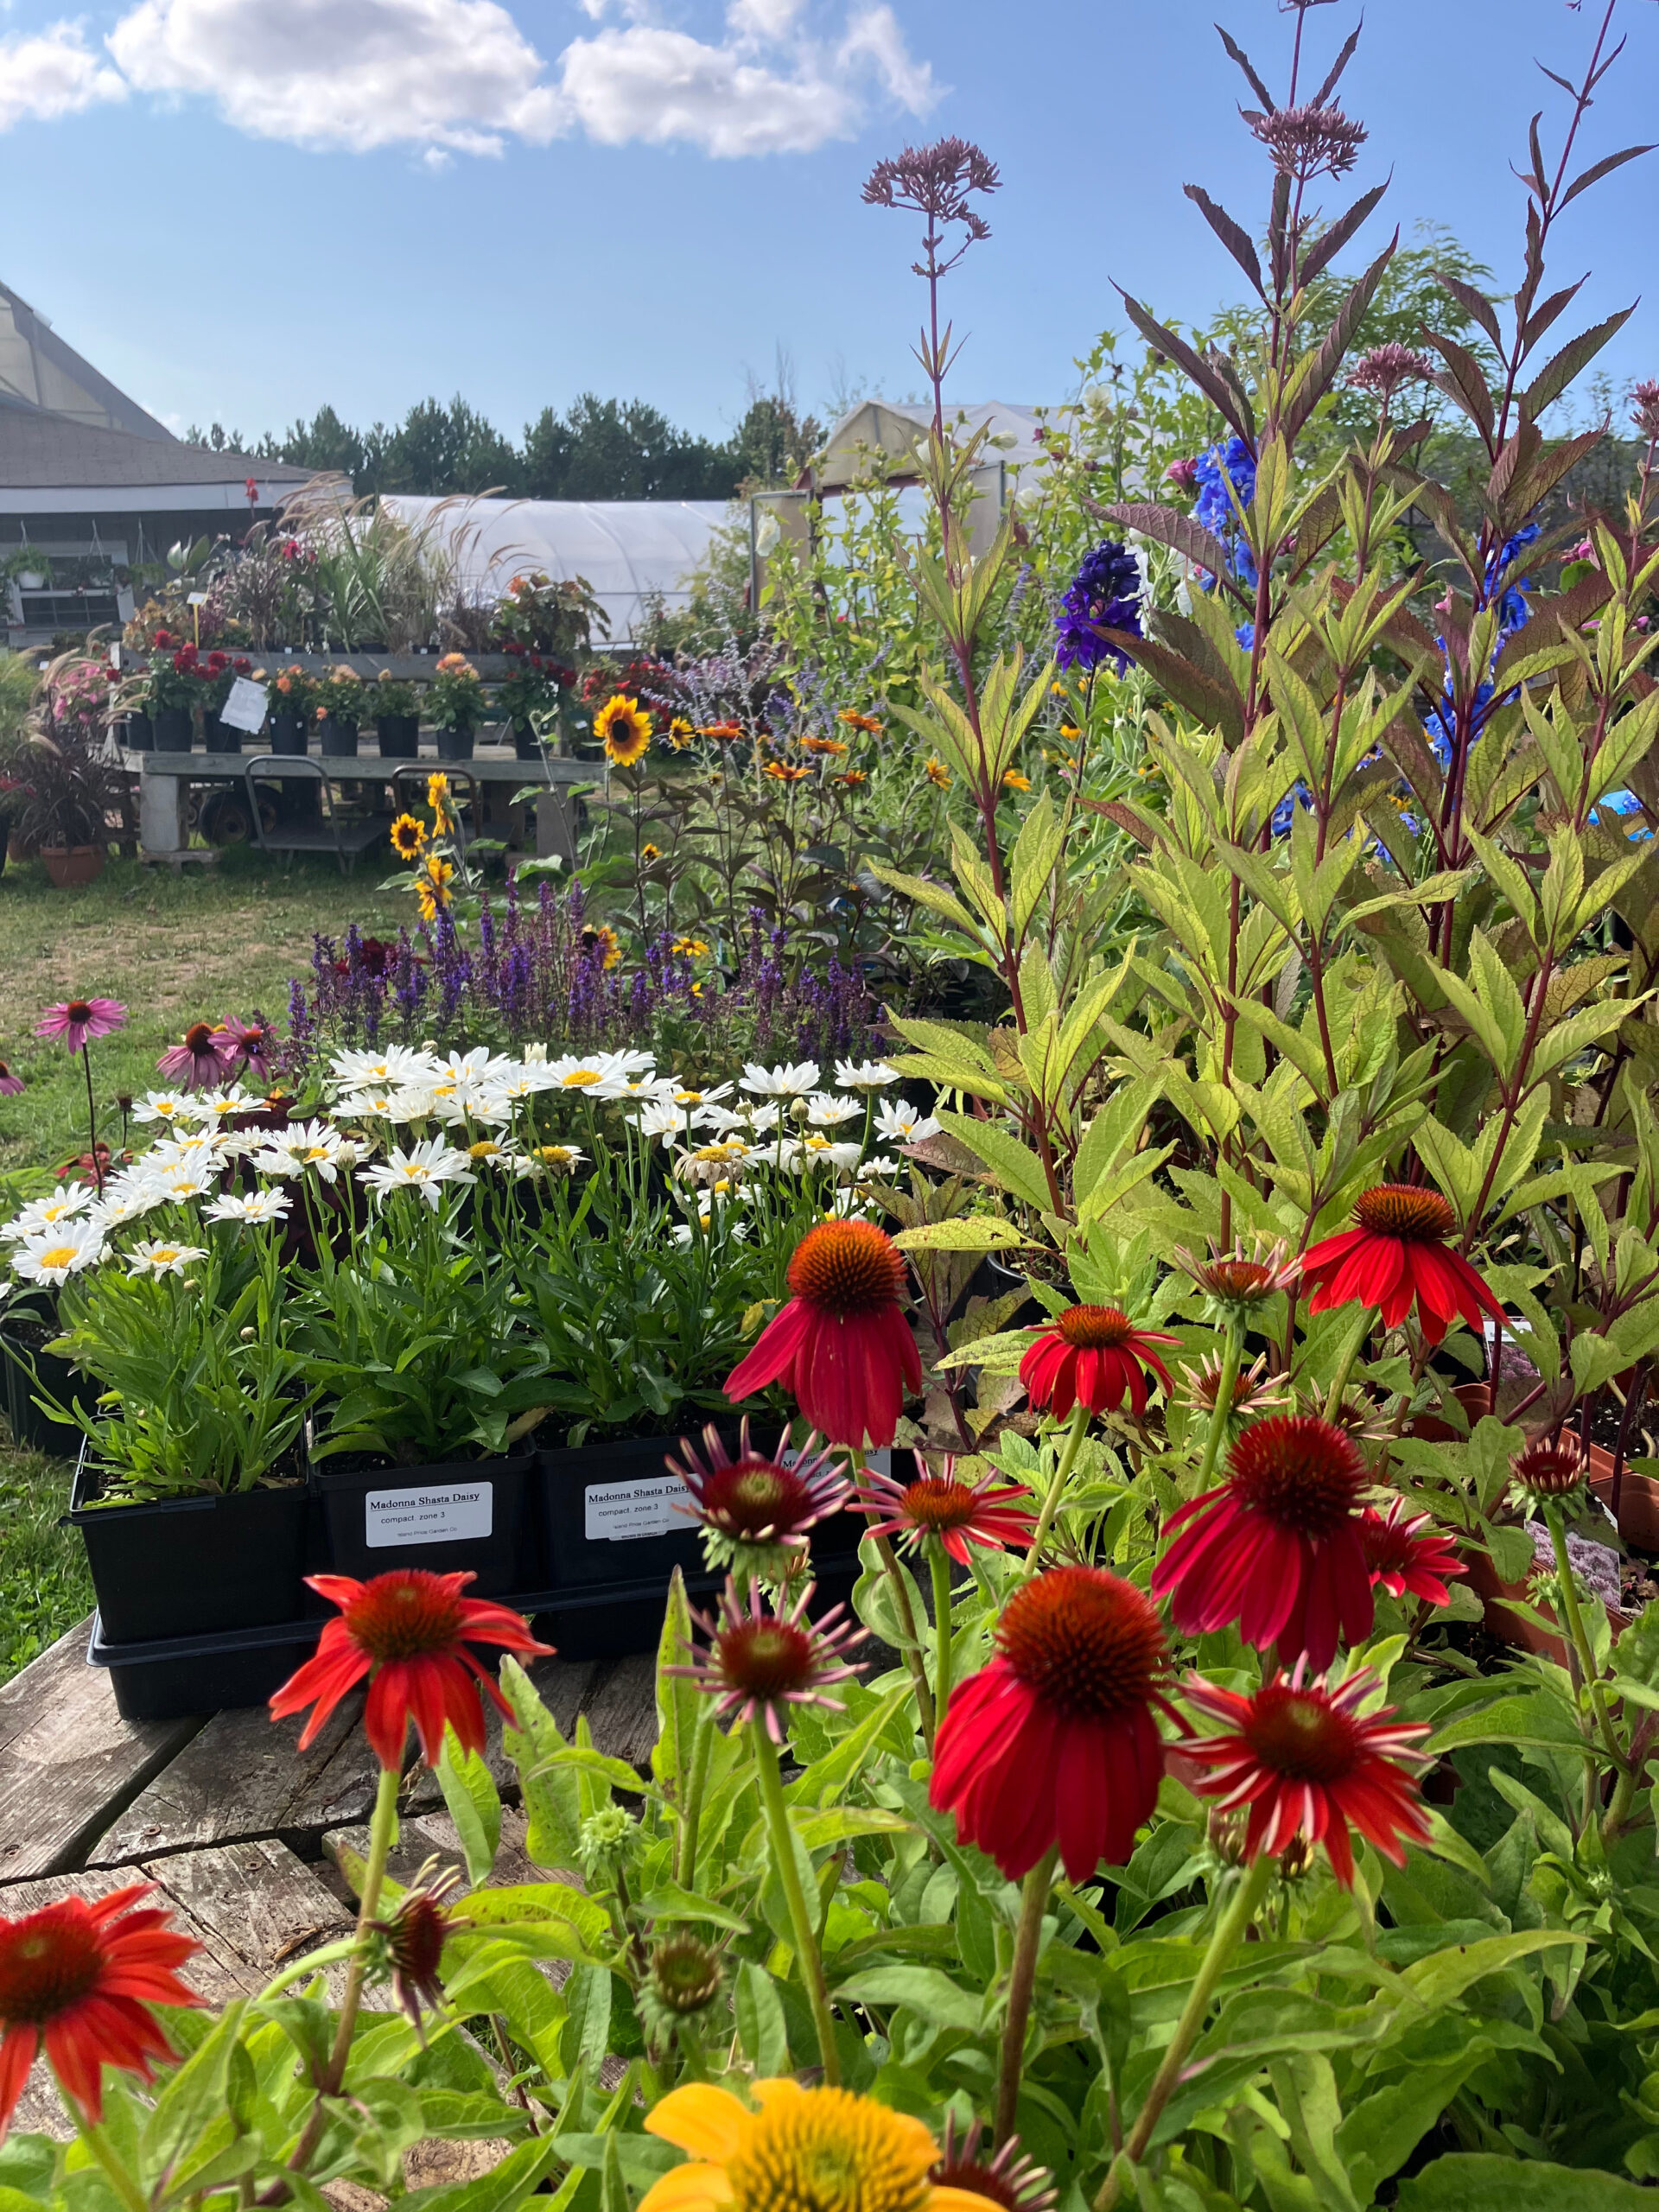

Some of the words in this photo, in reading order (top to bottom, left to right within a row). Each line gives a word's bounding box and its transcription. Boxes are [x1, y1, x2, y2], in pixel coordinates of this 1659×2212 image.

[370, 1499, 416, 1510] Madonna
[418, 1496, 449, 1506] Shasta
[453, 1492, 480, 1502] Daisy
[588, 1492, 631, 1503] Madonna
[633, 1488, 663, 1497] Shasta
